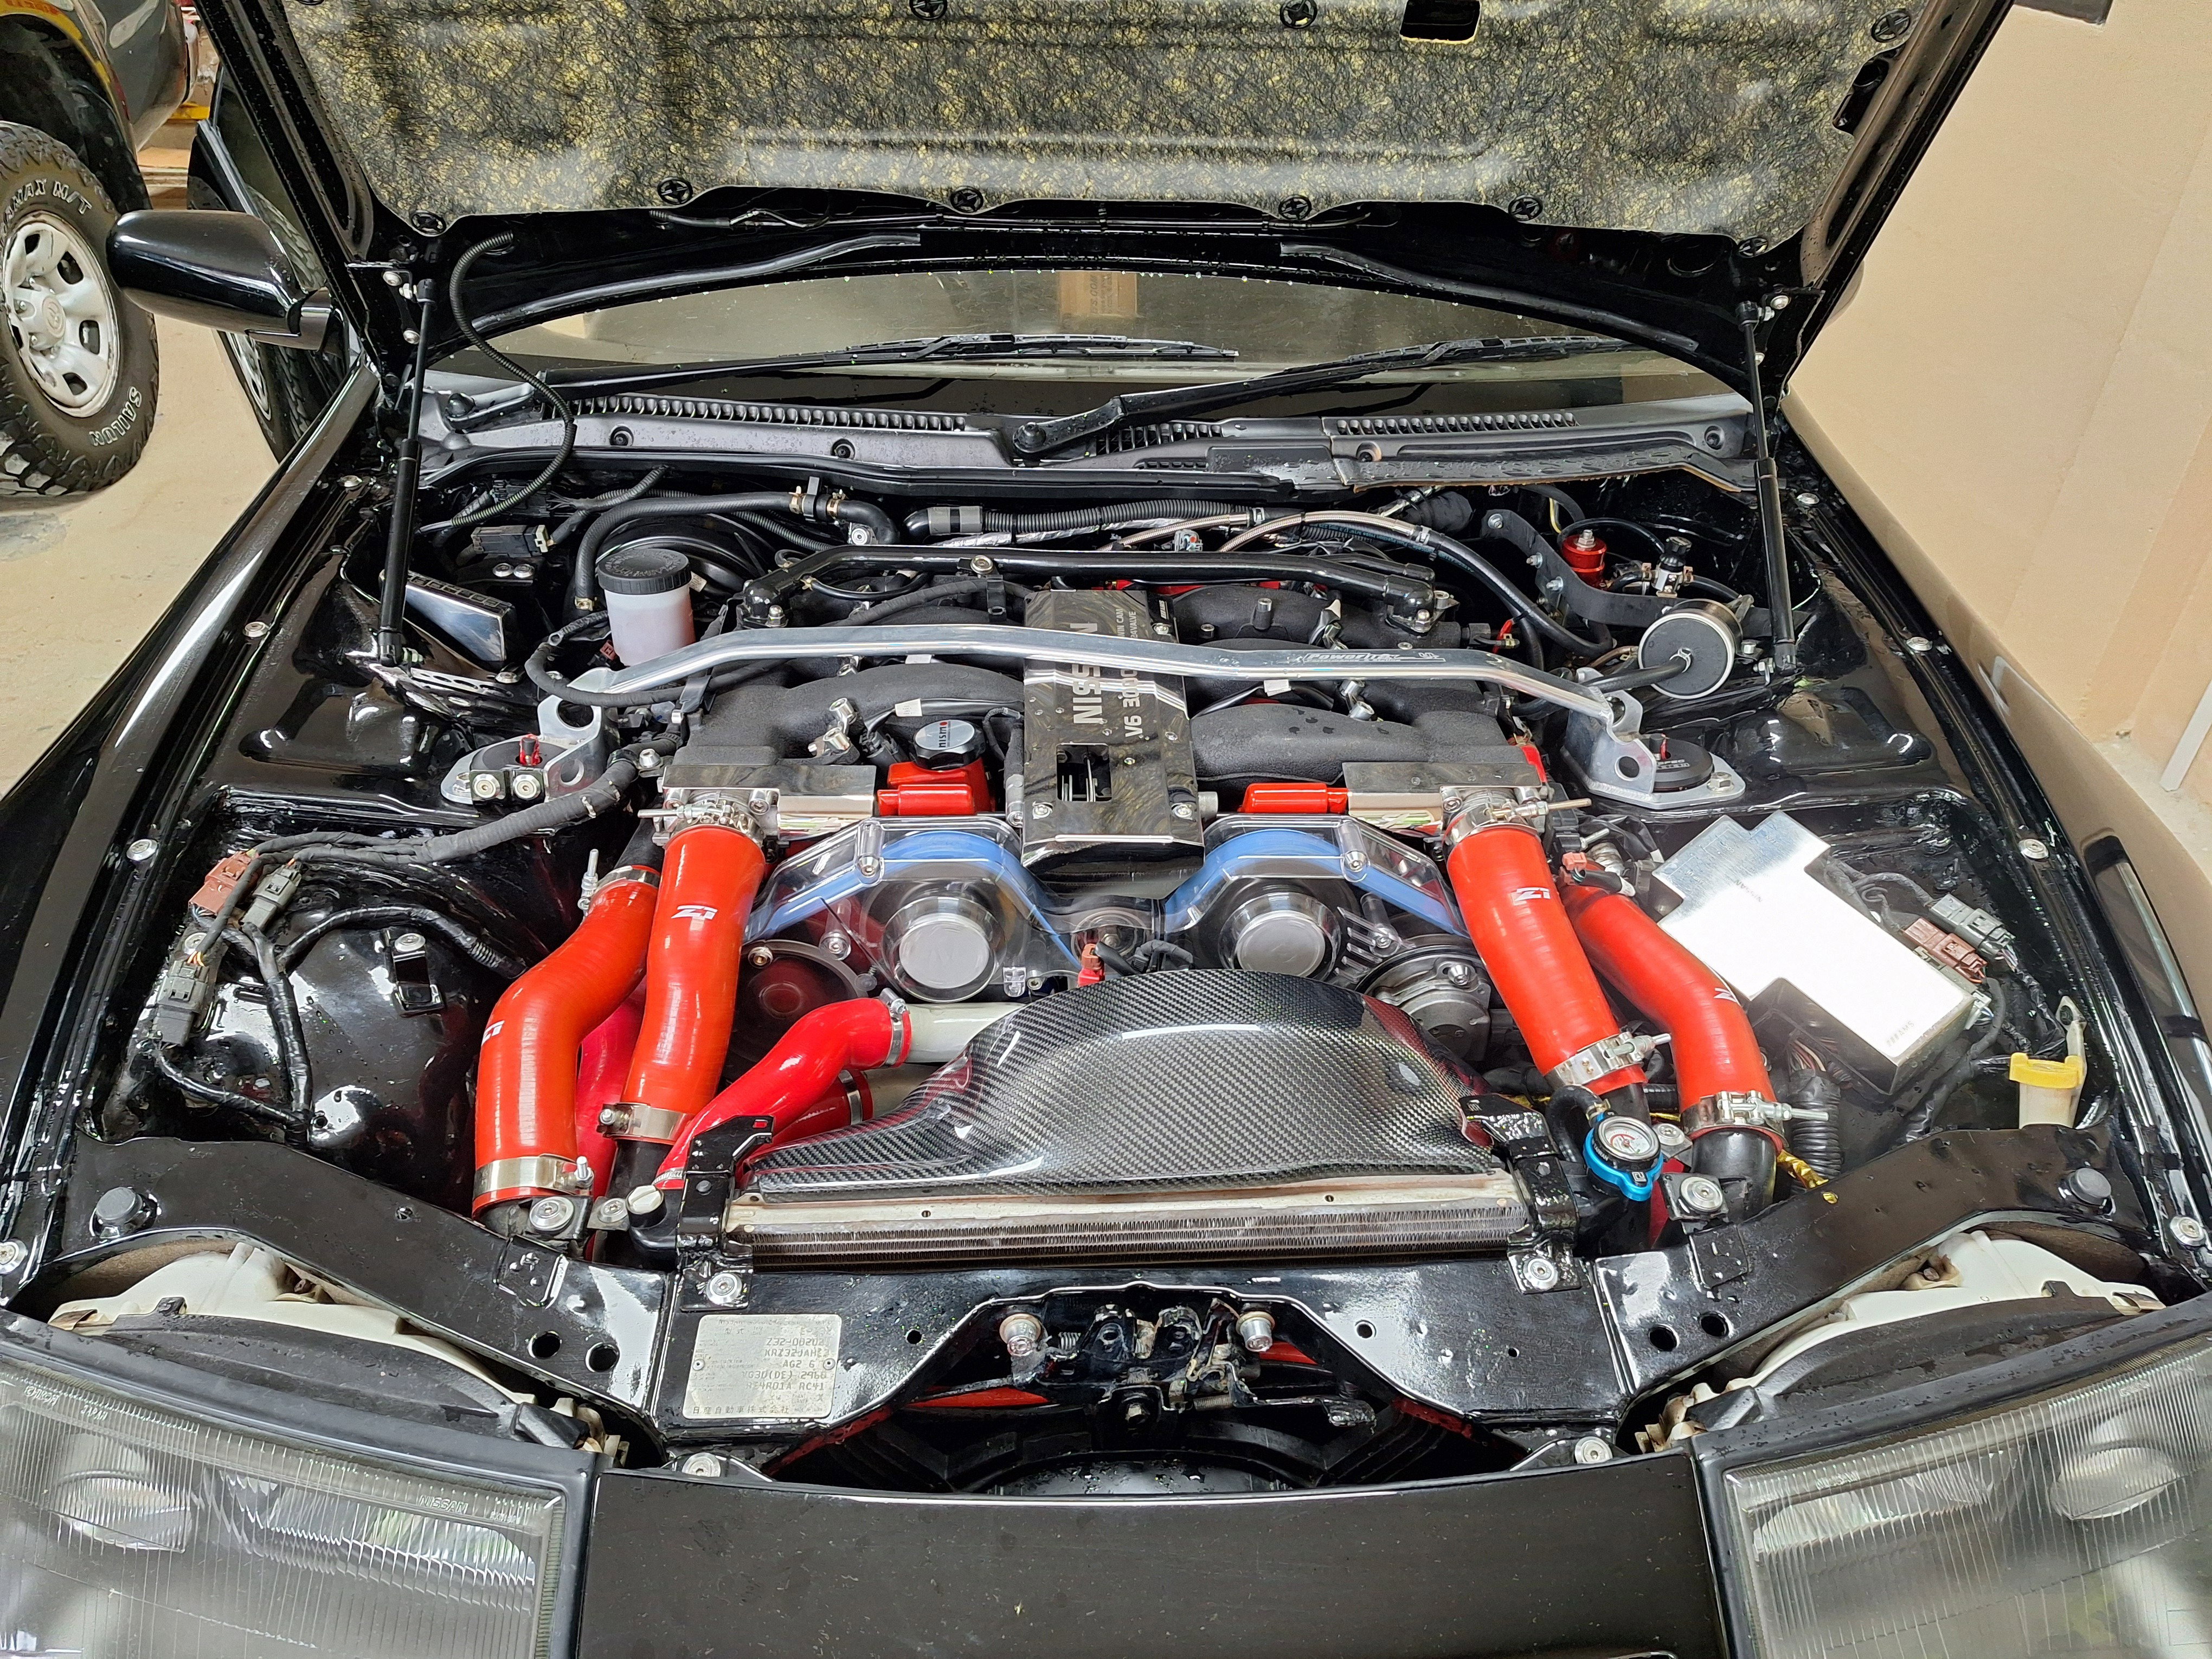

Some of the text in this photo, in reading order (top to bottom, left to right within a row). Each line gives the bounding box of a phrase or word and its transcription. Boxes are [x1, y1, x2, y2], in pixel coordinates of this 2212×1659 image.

[53, 180, 93, 214] M/T
[89, 386, 142, 446] SAILUN
[1115, 608, 1125, 636] WIN CAM
[1129, 611, 1138, 638] 24VALVE
[1124, 715, 1143, 737] V6
[80, 1404, 109, 1421] JAPAN
[419, 1494, 469, 1515] NISSAN
